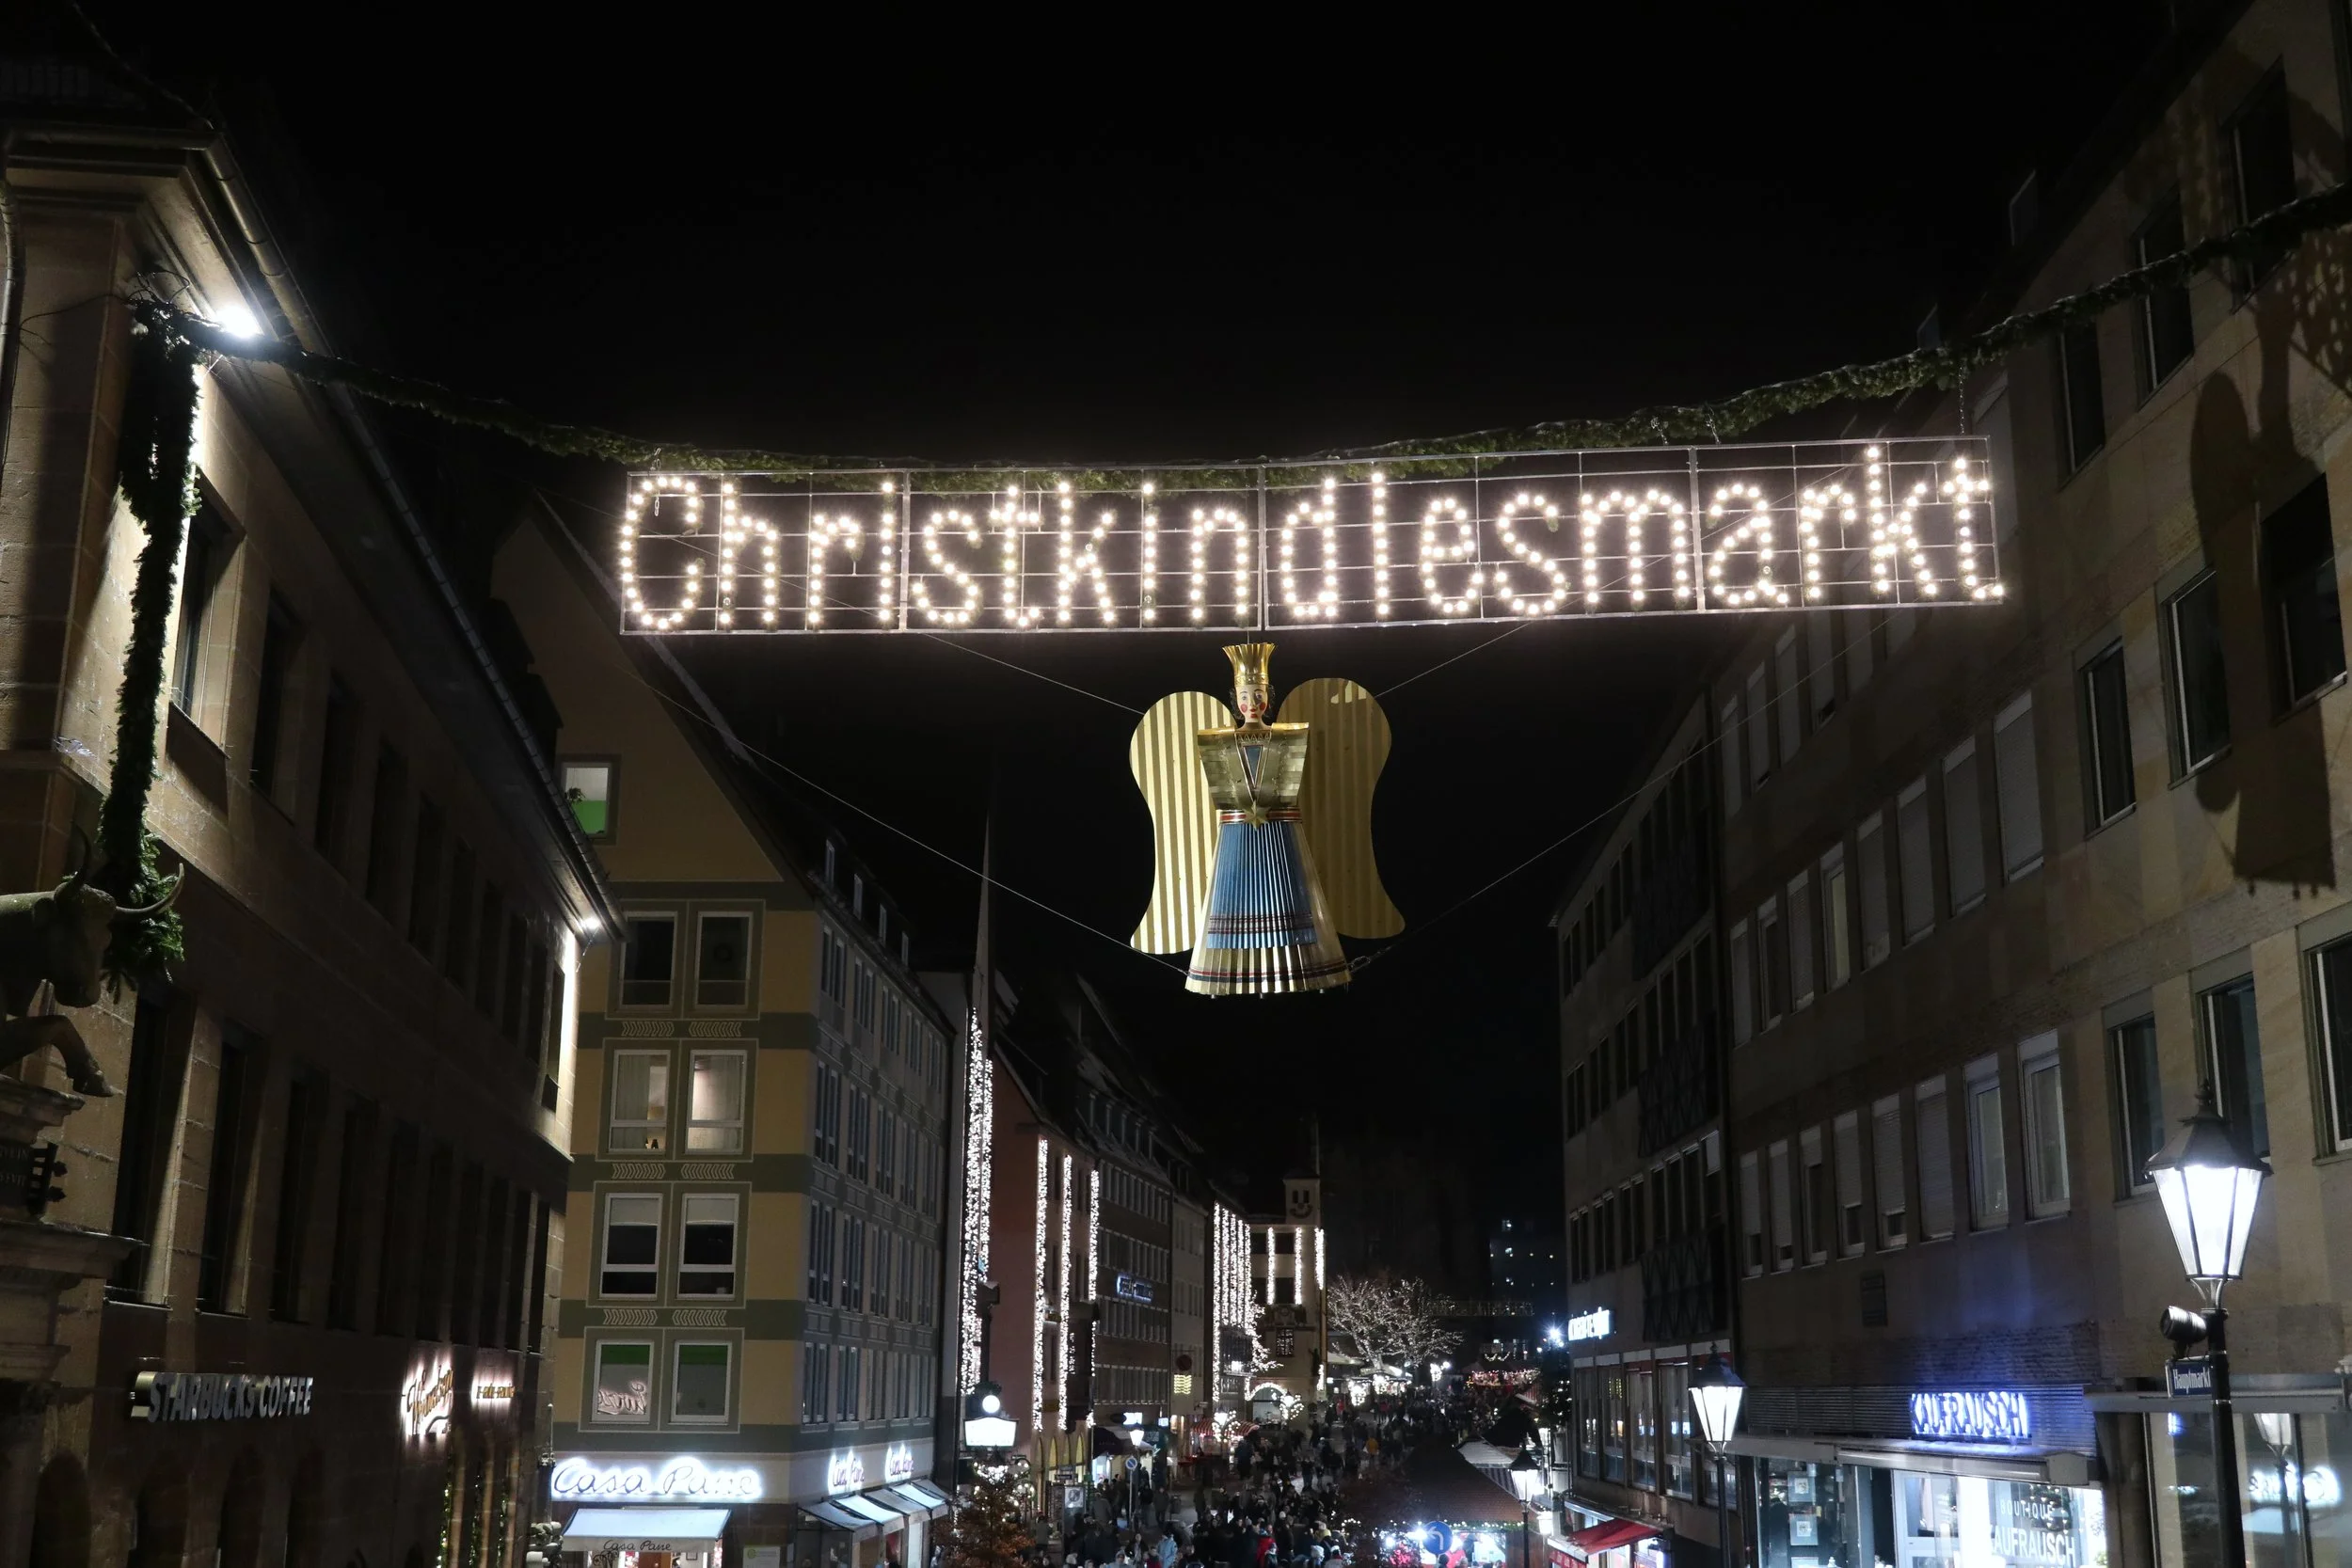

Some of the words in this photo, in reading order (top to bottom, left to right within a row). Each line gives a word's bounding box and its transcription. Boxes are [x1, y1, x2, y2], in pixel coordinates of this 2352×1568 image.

[617, 443, 2007, 629] Christkindlesmarkt
[148, 1372, 255, 1423] STARBUCKS
[259, 1375, 314, 1418] COFFEE
[1911, 1391, 2030, 1436] KAUFRAUSCH
[552, 1462, 647, 1495] Casa
[2000, 1500, 2053, 1521] BOUTIQUE
[603, 1539, 637, 1551] Casa
[639, 1540, 673, 1551] Pane
